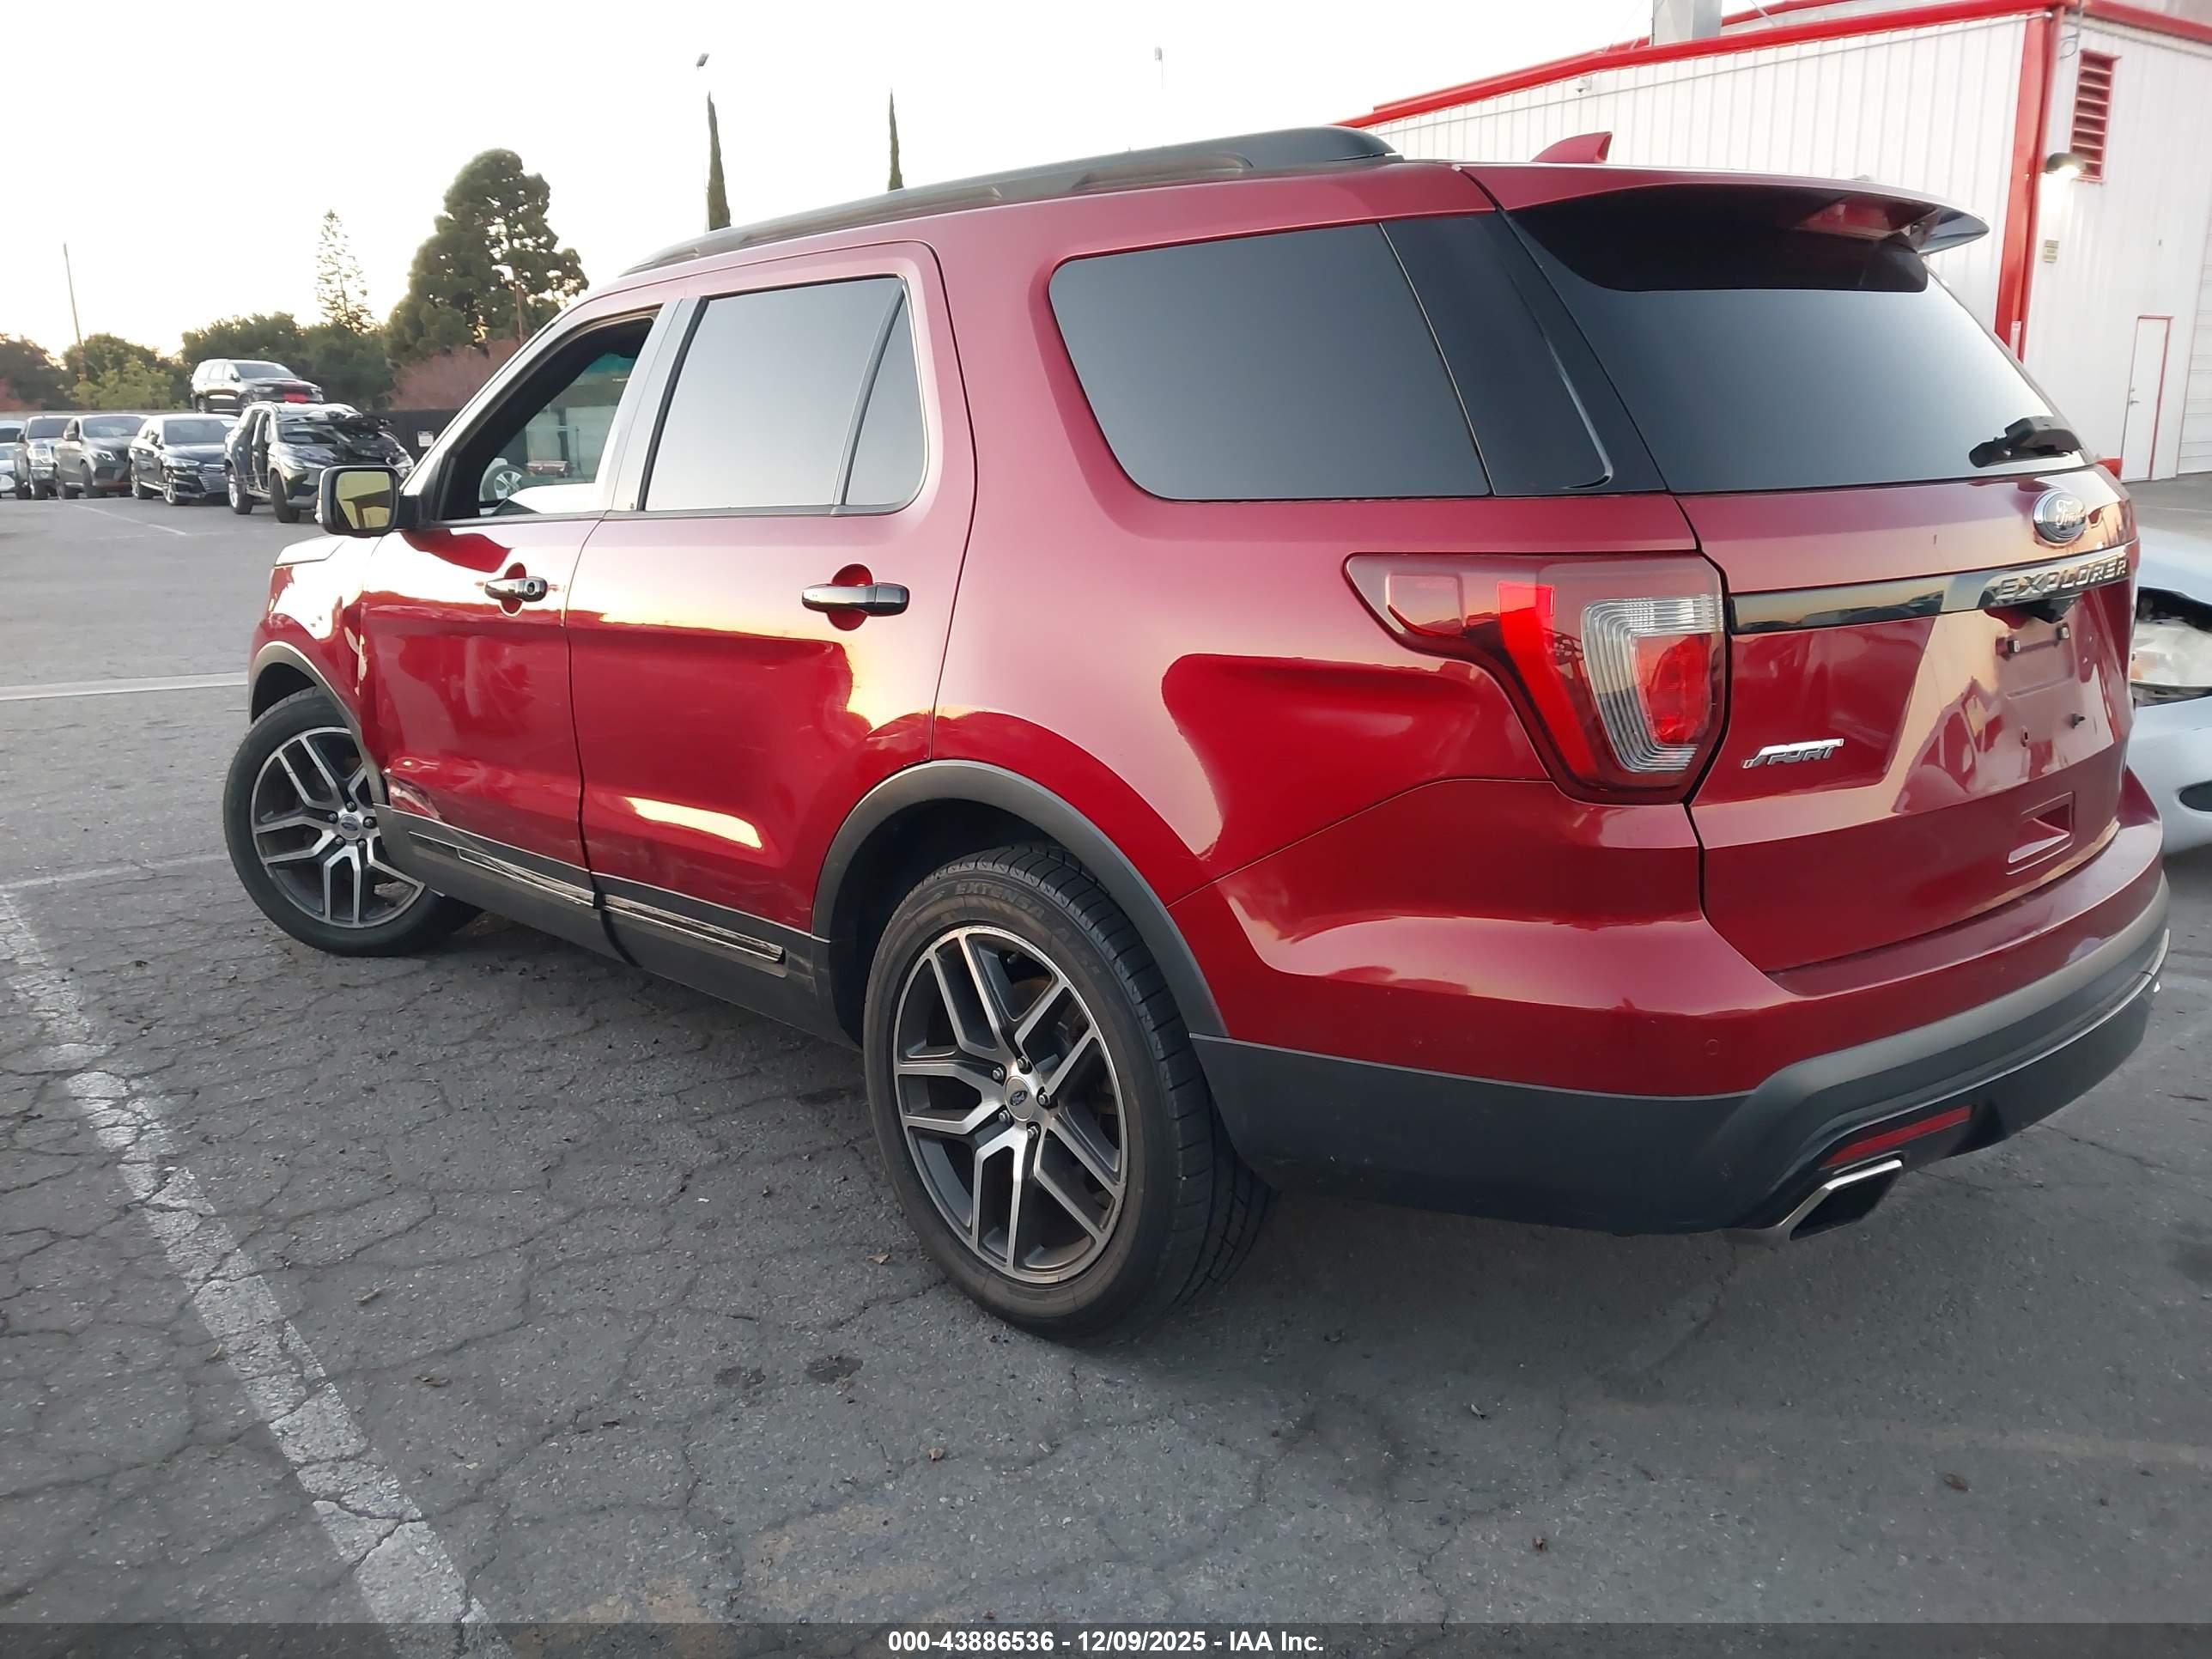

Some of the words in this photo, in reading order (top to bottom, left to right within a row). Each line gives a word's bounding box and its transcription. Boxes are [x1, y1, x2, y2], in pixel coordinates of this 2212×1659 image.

[2055, 499, 2087, 529] Ford
[1995, 556, 2127, 600] EXPLORER
[1741, 738, 1844, 769] SPORT
[955, 881, 1045, 918] EXTENSA
